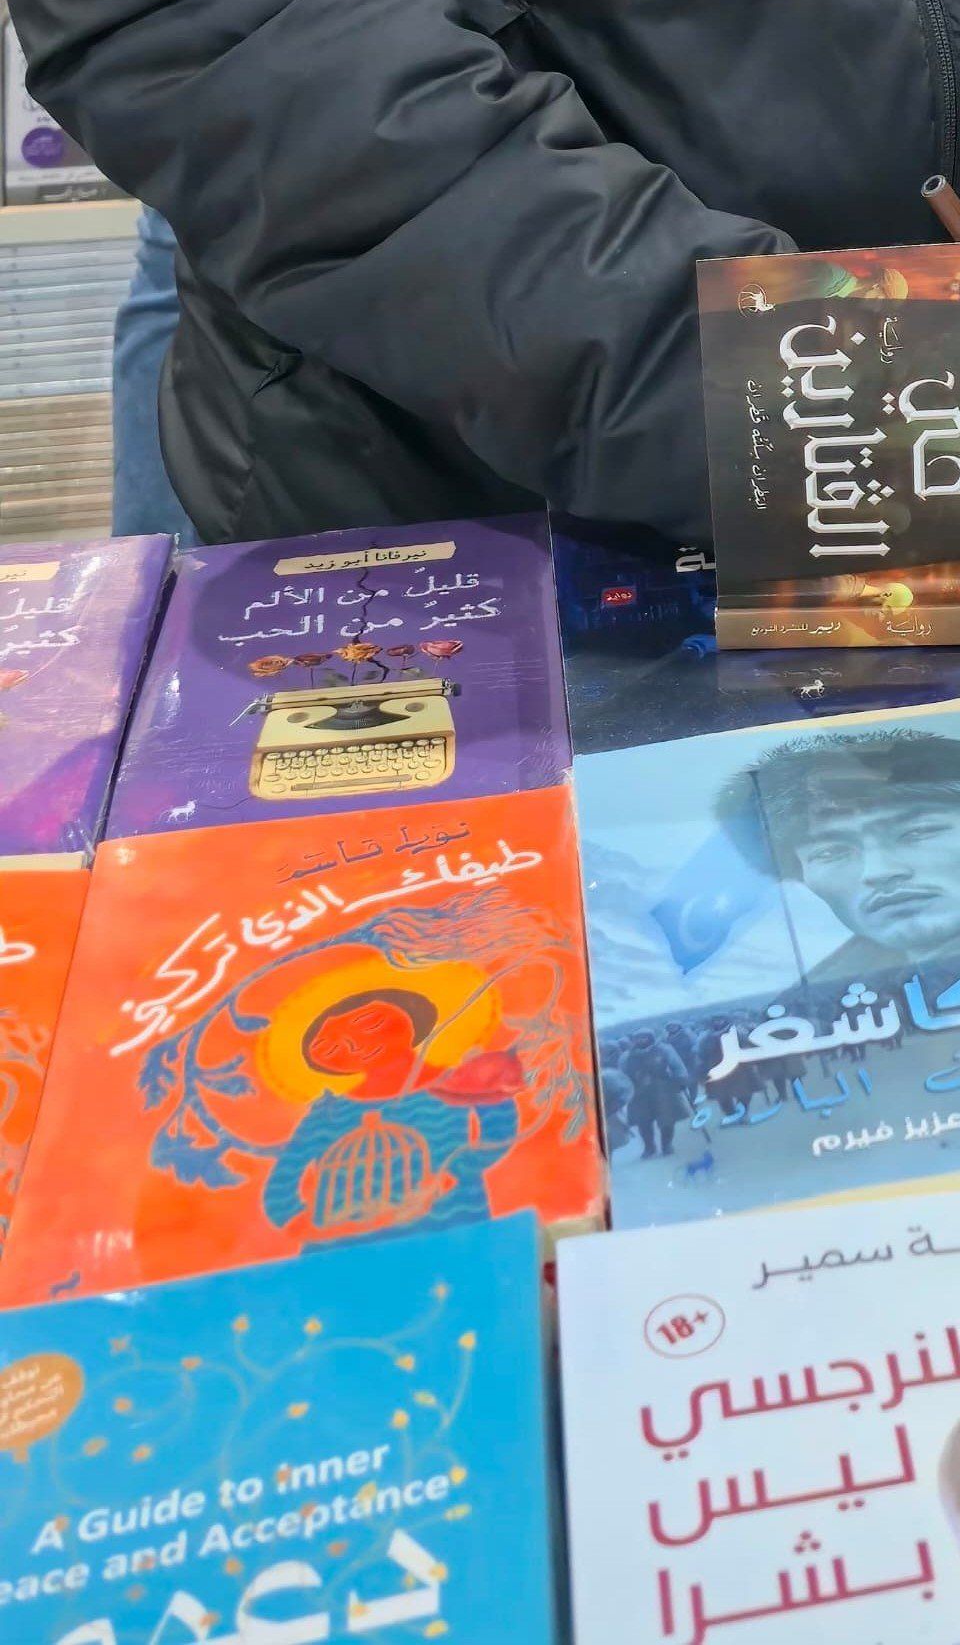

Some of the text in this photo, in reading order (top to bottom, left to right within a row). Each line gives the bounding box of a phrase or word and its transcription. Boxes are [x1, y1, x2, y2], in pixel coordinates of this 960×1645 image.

[244, 585, 325, 620] الألم
[337, 588, 390, 606] من
[218, 614, 325, 647] الحب
[340, 617, 405, 638] من
[885, 619, 933, 639] رواية
[240, 885, 344, 951] الذي
[752, 1240, 894, 1290] سمير
[655, 1310, 711, 1347] 18+
[648, 1423, 917, 1547] ليس
[31, 1519, 64, 1554] A
[77, 1488, 207, 1545] Guide
[219, 1474, 264, 1508] to
[0, 1470, 451, 1605] eace and Acceptance
